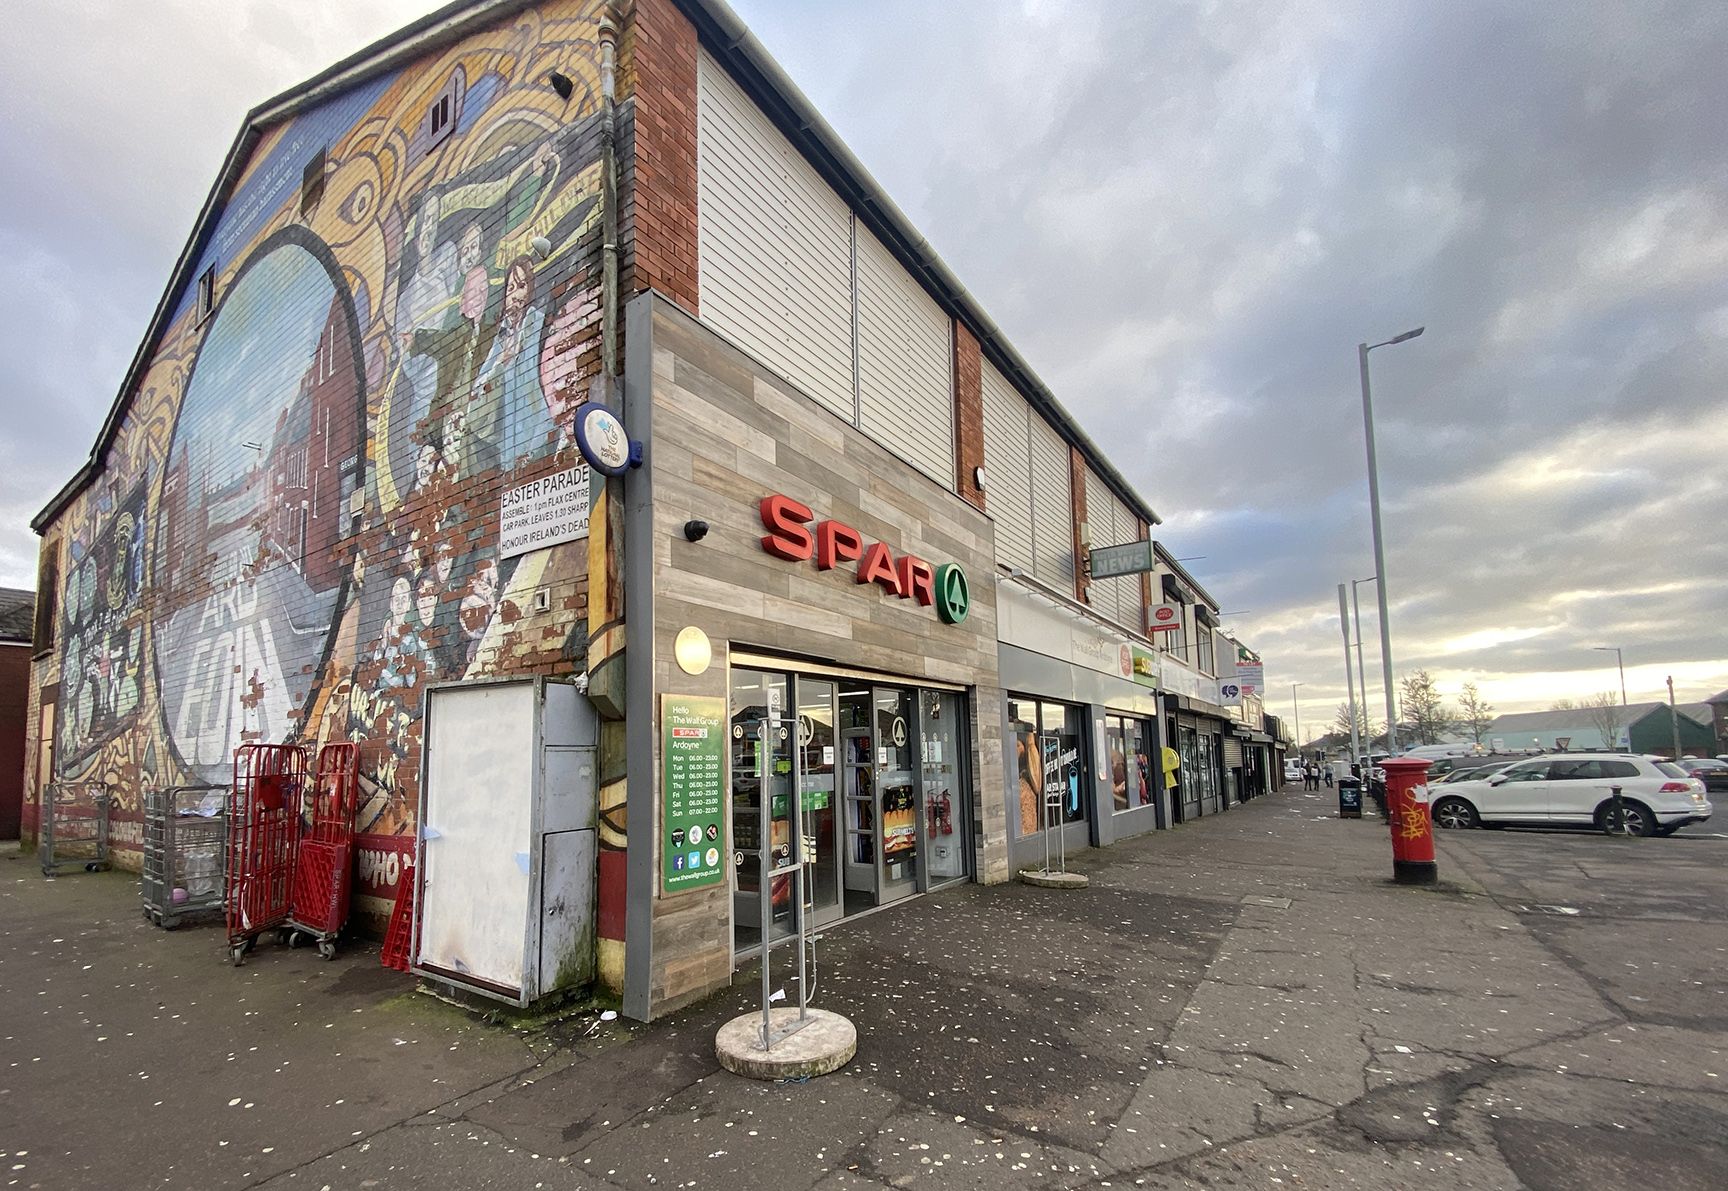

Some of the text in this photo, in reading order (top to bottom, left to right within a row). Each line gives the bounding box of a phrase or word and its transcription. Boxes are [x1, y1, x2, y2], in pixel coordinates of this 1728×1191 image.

[502, 465, 589, 509] EASTER PARADE
[548, 494, 564, 507] FLAX
[564, 487, 589, 503] CENTRE
[503, 521, 514, 533] CAR
[531, 510, 554, 525] LEAVES
[554, 508, 567, 519] 1.30
[567, 501, 589, 516] SHARP
[502, 517, 589, 551] HONOUR IRELAND'S DEAD
[760, 494, 934, 607] SPAR
[1097, 553, 1146, 574] NEWS
[672, 705, 690, 715] Hello
[672, 715, 686, 725] The
[700, 717, 720, 727] Group
[672, 740, 700, 751] Ardoyne
[672, 754, 685, 762] Mon
[672, 763, 684, 771] Tue
[672, 791, 681, 799] Fri
[672, 800, 682, 808] Sat
[672, 809, 684, 817] Sun
